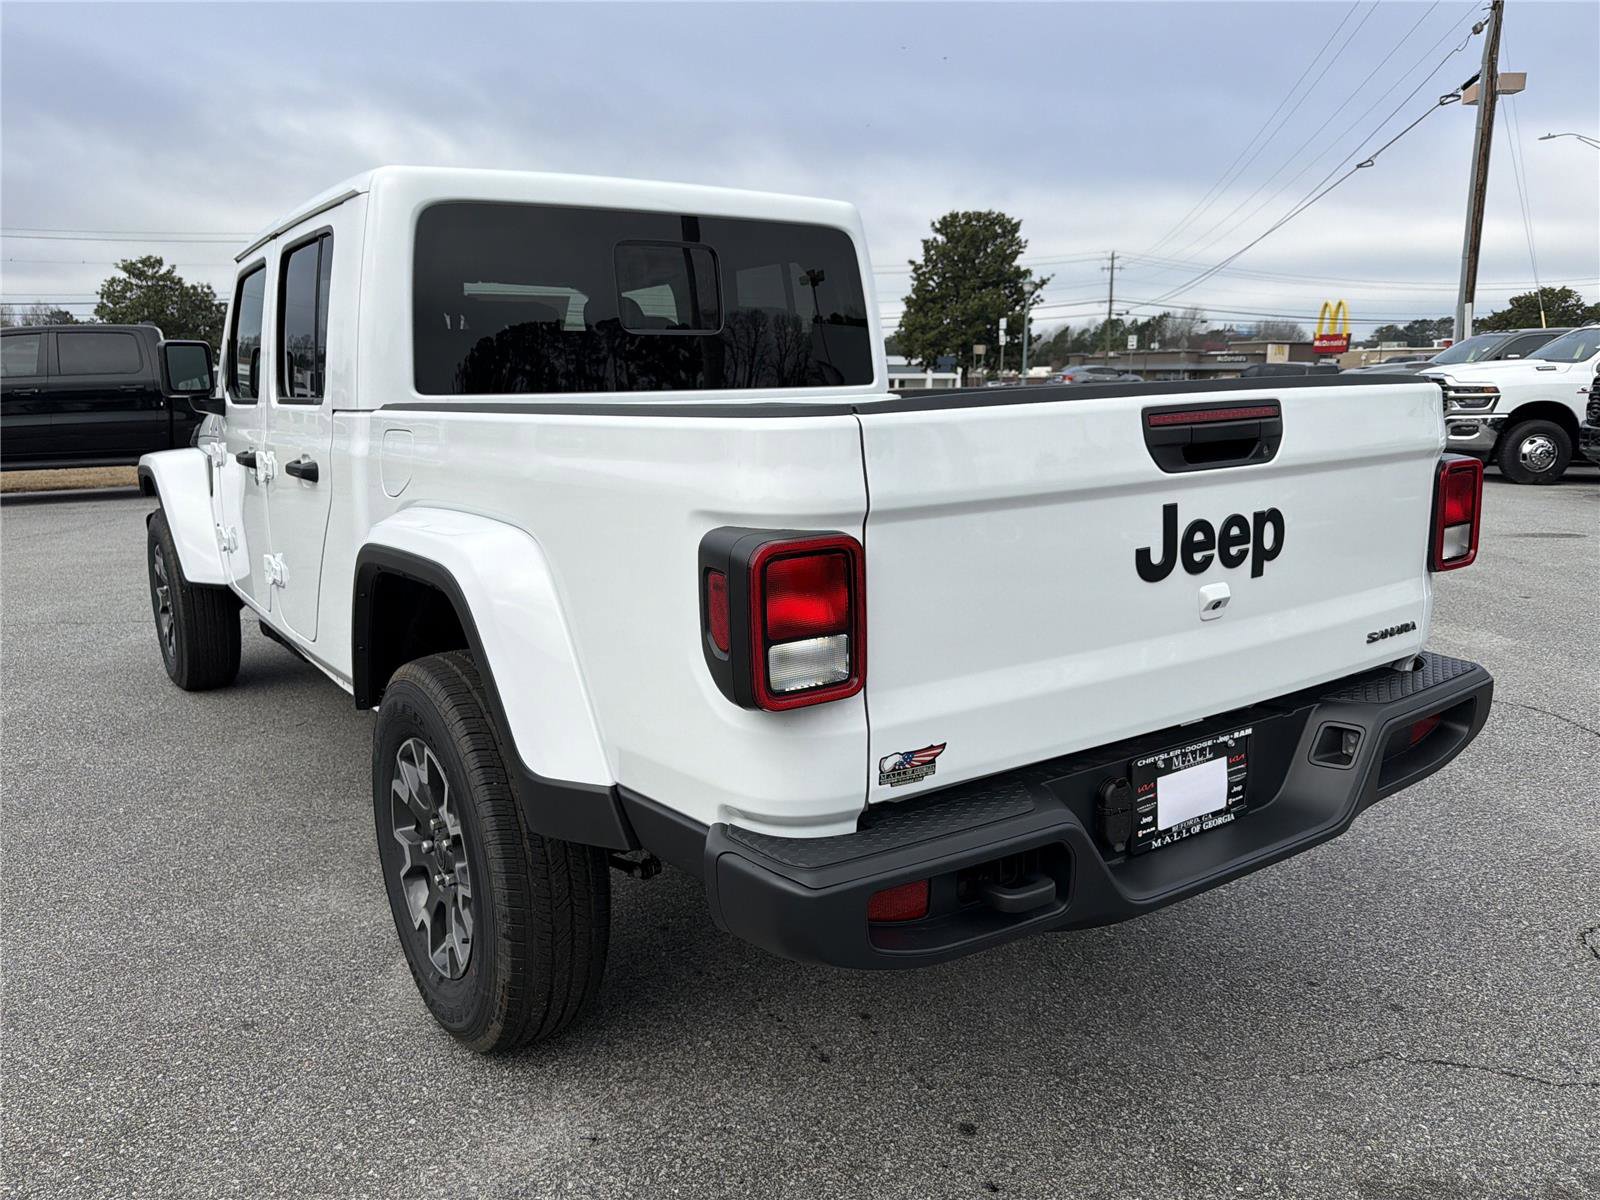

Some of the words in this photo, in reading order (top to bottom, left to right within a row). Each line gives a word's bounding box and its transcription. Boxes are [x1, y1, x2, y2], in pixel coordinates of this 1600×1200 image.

[1135, 502, 1285, 583] Jeep
[1366, 620, 1417, 644] SAHARA
[1137, 749, 1181, 767] CHRYSLER
[1185, 739, 1214, 753] DODGE
[1233, 728, 1252, 738] RAM
[1191, 822, 1202, 834] OF
[1203, 814, 1235, 830] GEORGIA
